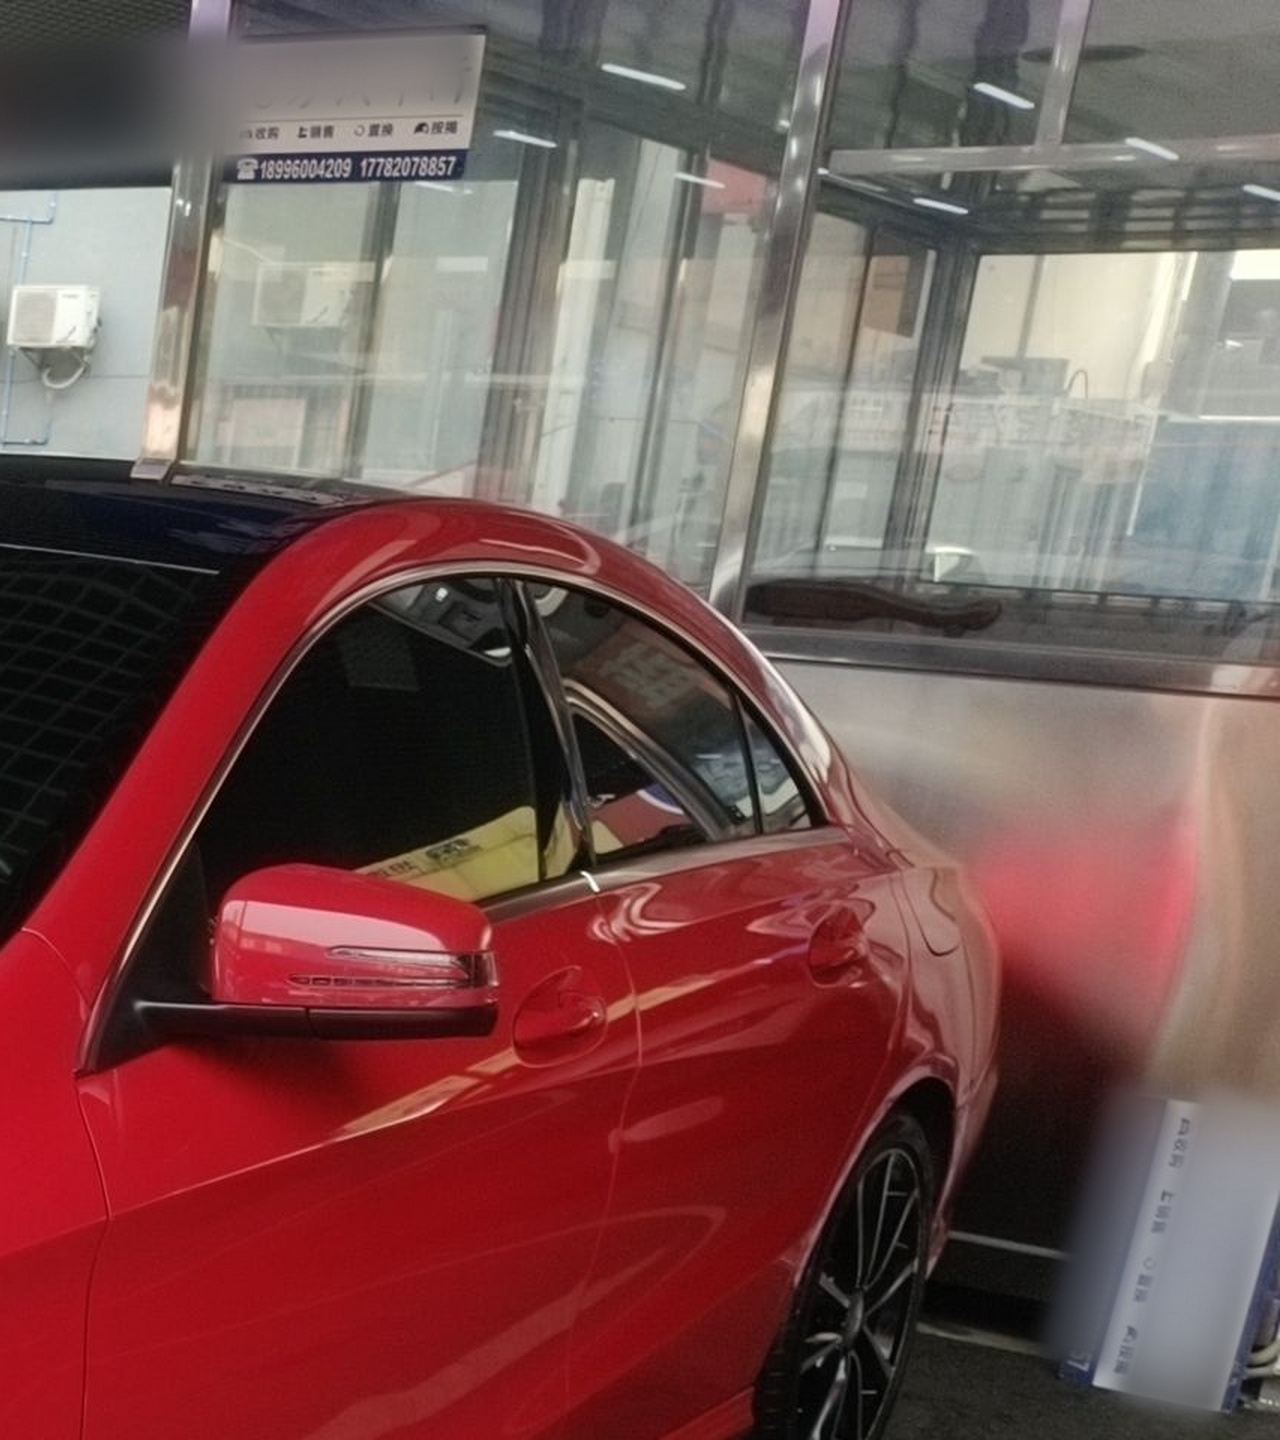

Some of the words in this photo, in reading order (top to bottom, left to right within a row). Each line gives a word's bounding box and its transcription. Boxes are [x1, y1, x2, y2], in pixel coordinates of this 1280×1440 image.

[368, 123, 393, 137] 置换
[430, 121, 458, 135] 按揭
[259, 157, 353, 181] 18996004209
[359, 156, 457, 178] 17782078857
